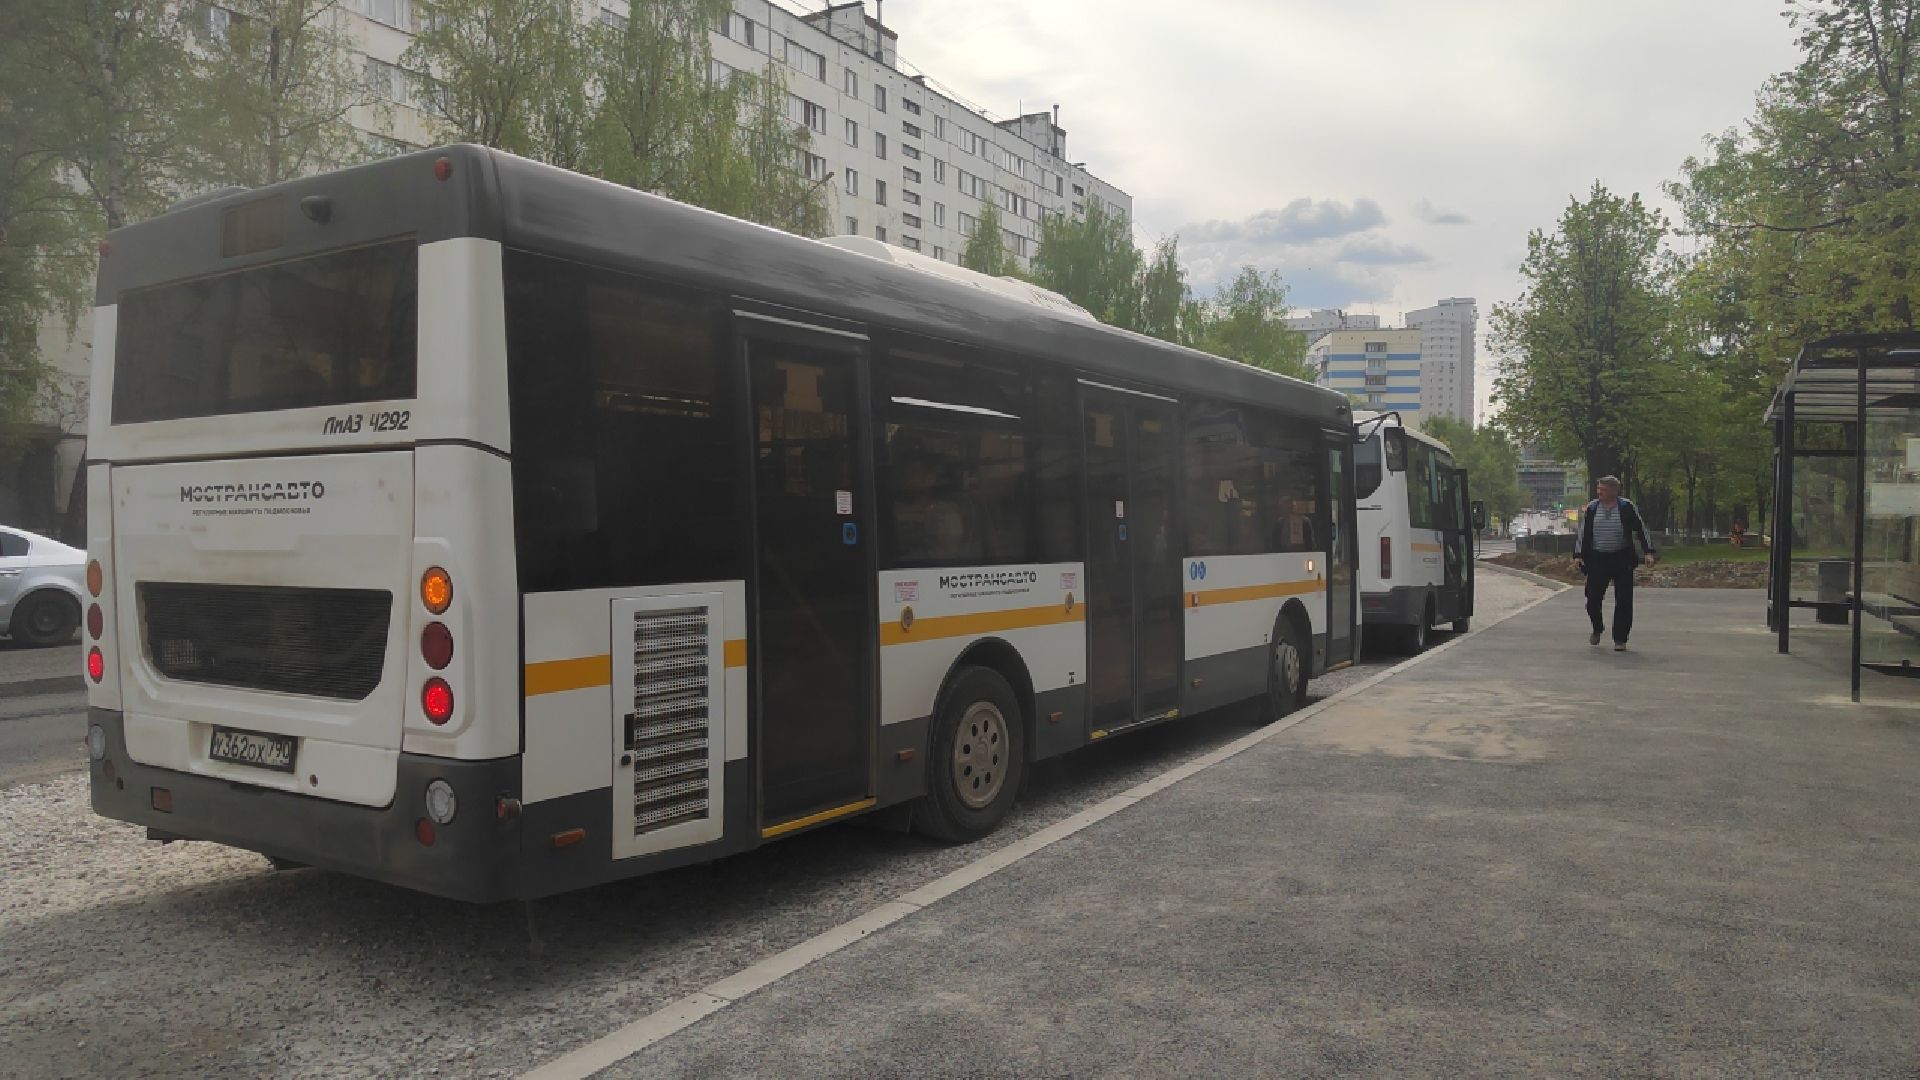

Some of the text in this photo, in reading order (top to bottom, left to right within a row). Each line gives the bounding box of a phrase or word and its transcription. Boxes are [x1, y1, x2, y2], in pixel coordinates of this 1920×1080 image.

[369, 410, 411, 432] 4292
[180, 481, 325, 502] МОСТРАНСАВТО
[939, 571, 1037, 589] МОСТРАНСАВТО
